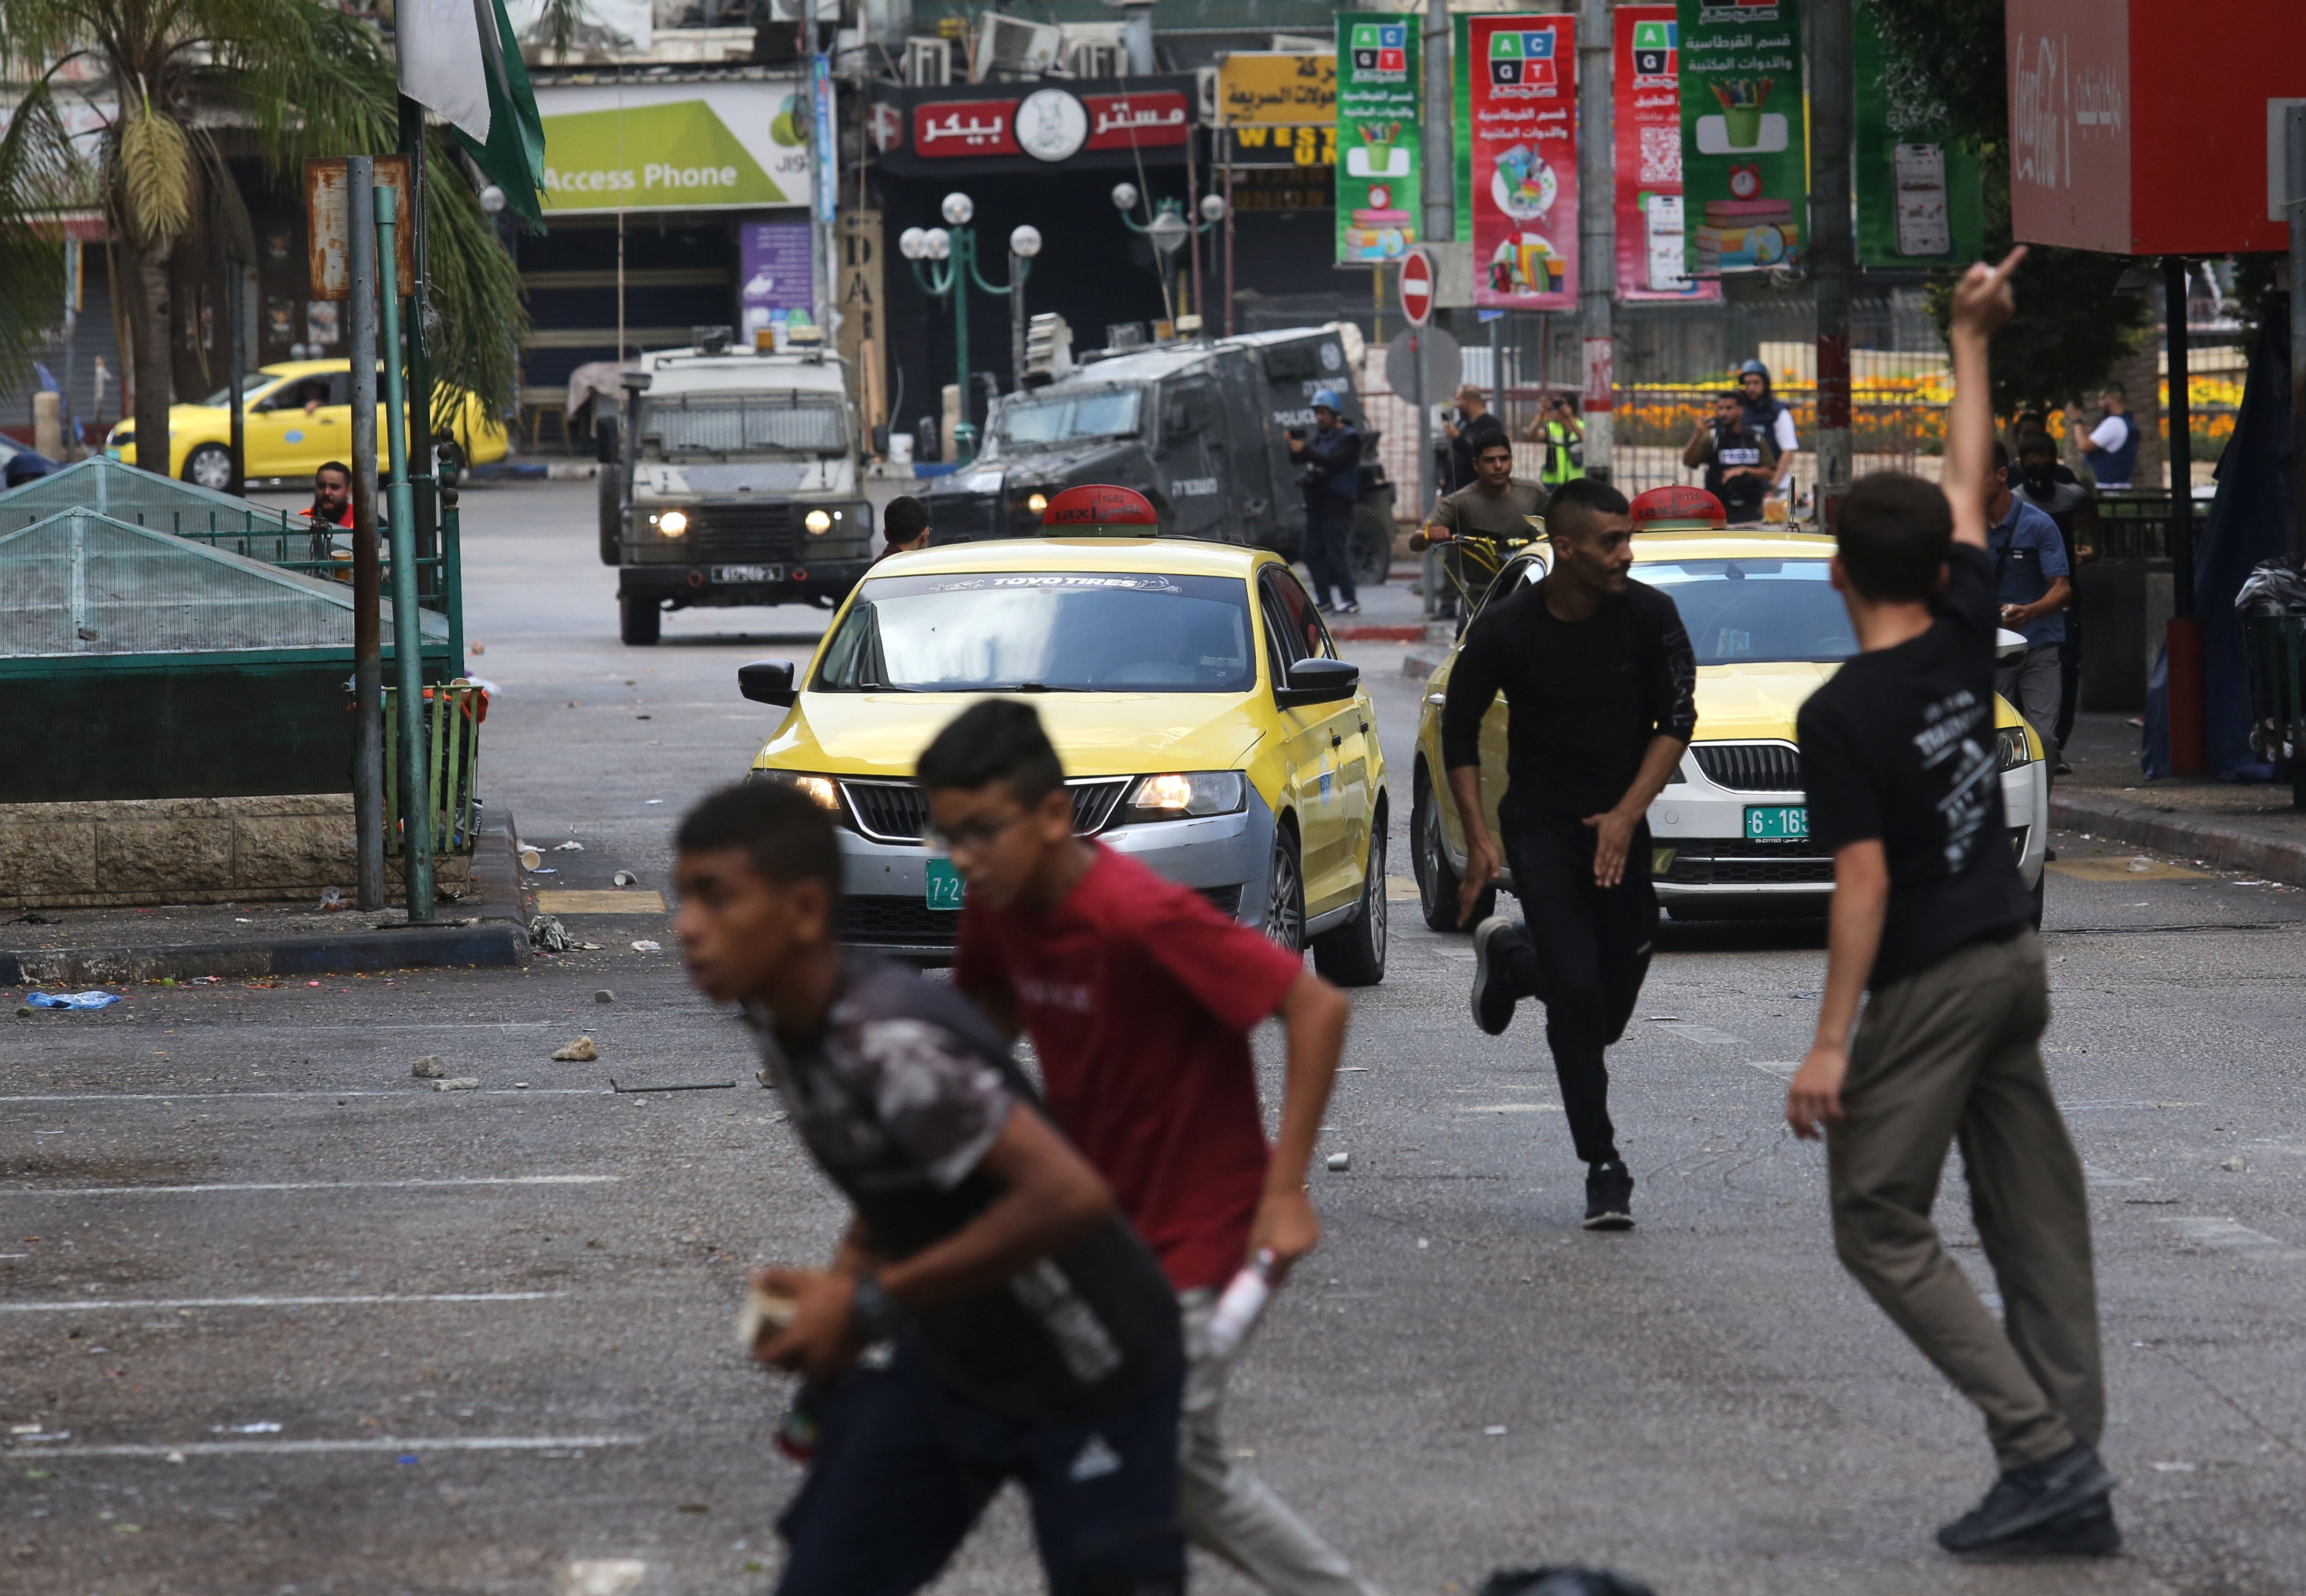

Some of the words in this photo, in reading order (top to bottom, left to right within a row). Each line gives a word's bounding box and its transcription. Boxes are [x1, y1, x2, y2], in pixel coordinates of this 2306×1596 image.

[1360, 31, 1371, 42] A
[1385, 30, 1397, 44] C
[1644, 29, 1656, 42] A
[1686, 34, 1753, 52] القرطاسية
[1756, 34, 1791, 50] قسم
[1500, 39, 1512, 52] A
[1531, 38, 1543, 52] C
[1359, 53, 1371, 66] G
[1386, 53, 1396, 65] T
[1643, 55, 1657, 69] G
[1688, 57, 1735, 73] المكتبية
[1499, 64, 1513, 79] G
[1532, 64, 1543, 78] T
[1095, 102, 1185, 134] مستر
[1478, 108, 1535, 123] القرطاسية
[1536, 108, 1568, 123] قسم
[923, 113, 1003, 145] بيكر
[544, 167, 635, 192] Access
[645, 163, 737, 188] Phone
[1055, 500, 1097, 521] taxi
[1638, 499, 1677, 517] taxi
[994, 577, 1064, 587] TOYO
[1065, 577, 1138, 587] TIRES
